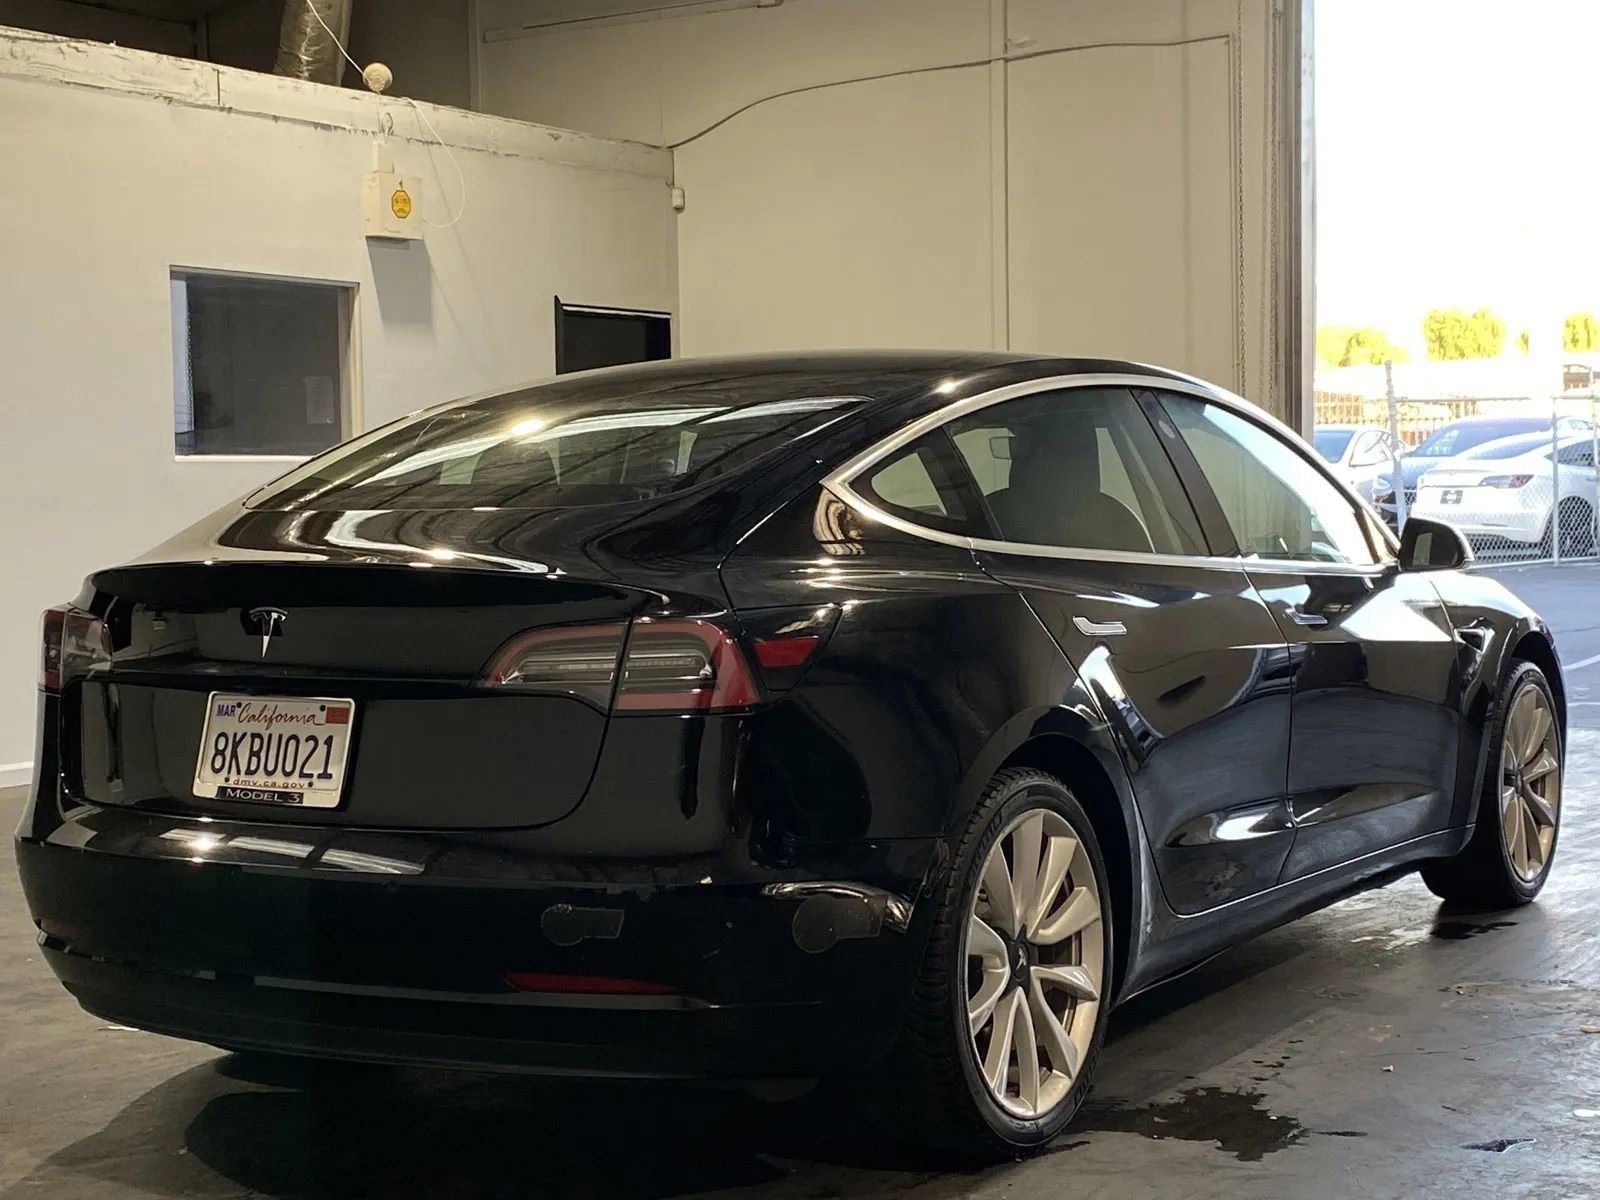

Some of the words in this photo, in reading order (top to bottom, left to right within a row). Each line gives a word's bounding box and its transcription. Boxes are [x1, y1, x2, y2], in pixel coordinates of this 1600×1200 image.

[216, 704, 236, 717] MAR
[237, 703, 325, 731] California
[211, 732, 334, 779] 8KBU021
[233, 779, 305, 789] dmv.ca.gov
[288, 793, 300, 803] 3
